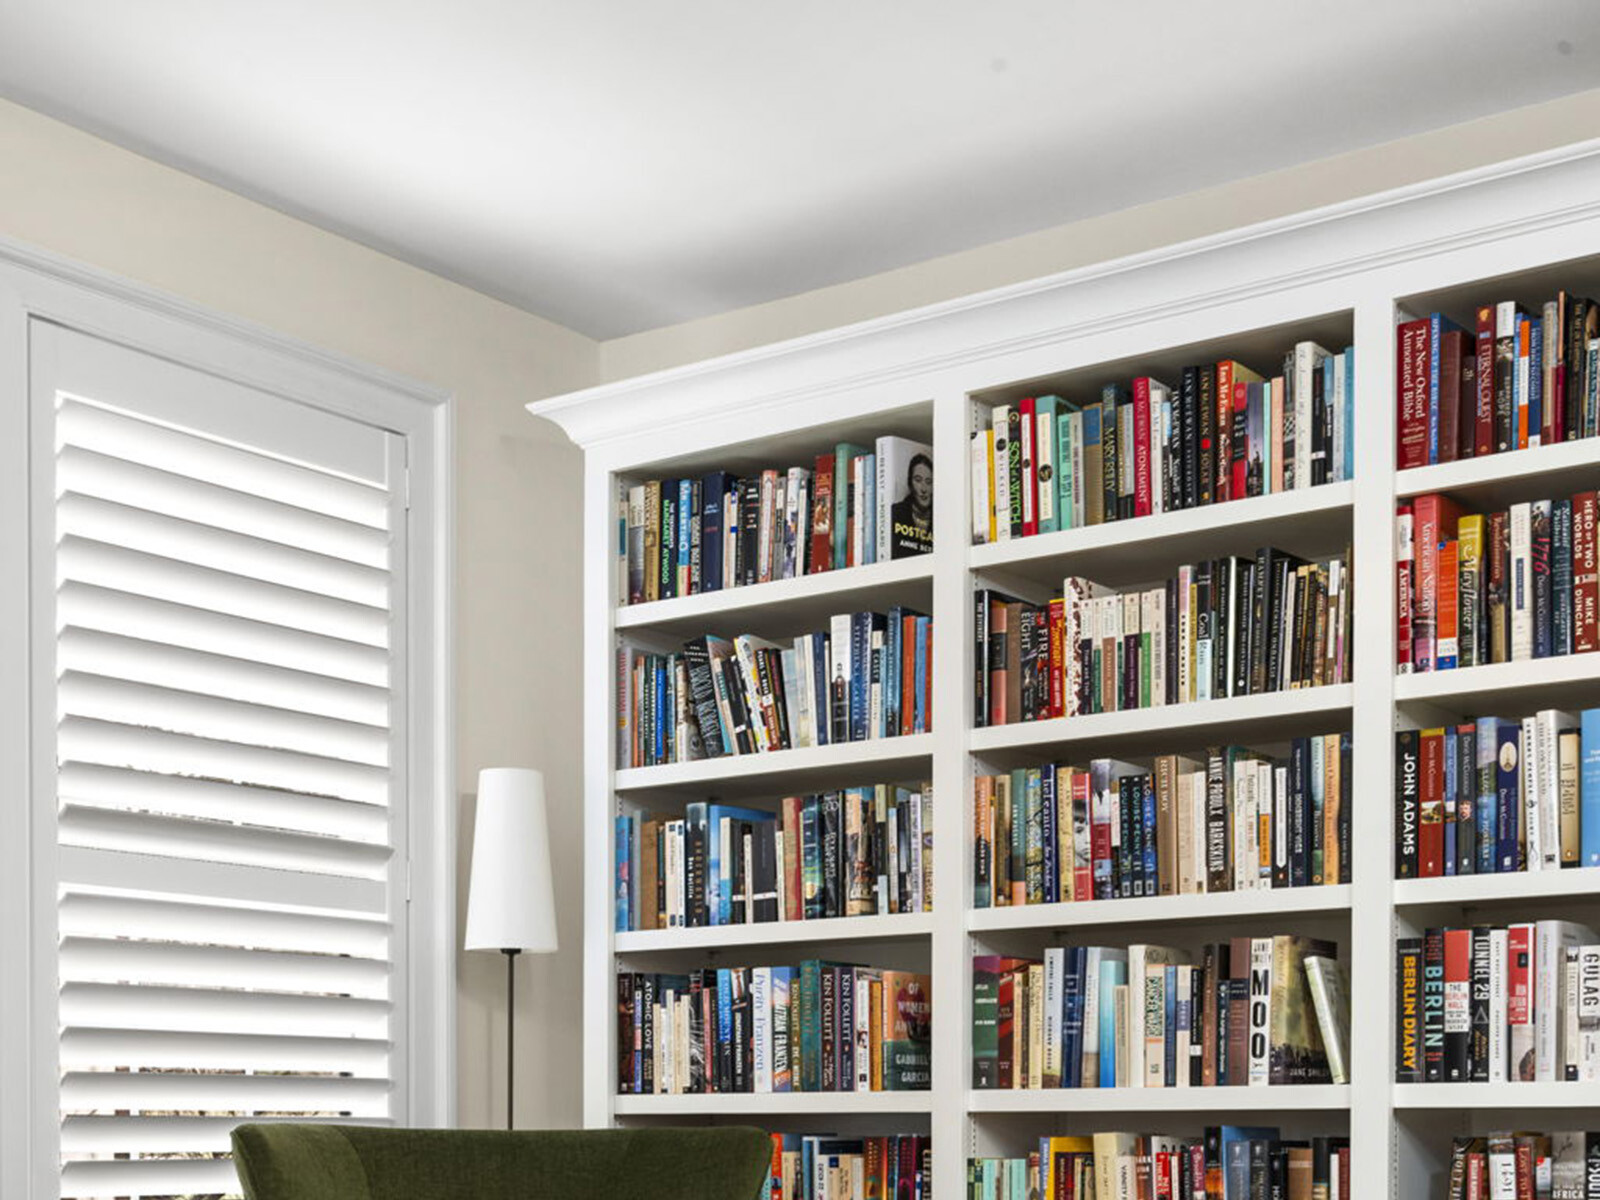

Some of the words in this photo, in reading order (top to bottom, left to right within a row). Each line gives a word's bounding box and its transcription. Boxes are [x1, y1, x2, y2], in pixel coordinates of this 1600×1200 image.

[1185, 374, 1193, 392] IAN
[1201, 370, 1210, 392] IAN
[1416, 350, 1428, 377] New
[1172, 390, 1180, 408] IAN
[1402, 390, 1414, 421] Bible
[1416, 378, 1428, 418] Oxford
[1139, 444, 1149, 503] ATONEMENT
[1200, 452, 1210, 485] SOLAR
[661, 500, 669, 546] MARGARET
[1584, 500, 1594, 530] HERO
[1574, 512, 1583, 560] WORLDS
[1584, 542, 1594, 568] TWO
[660, 548, 668, 584] ATWOOD
[1256, 556, 1266, 600] HAMNET
[1399, 568, 1409, 618] AMERICA
[1460, 544, 1478, 630] Mayflower
[1198, 612, 1210, 640] Coal
[1574, 589, 1584, 636] DUNCAN
[1585, 596, 1594, 626] MIKE
[1020, 612, 1032, 651] EIGHT
[1037, 628, 1049, 661] FIRE
[1403, 752, 1416, 795] JOHN
[1209, 783, 1224, 817] PROULX
[1209, 821, 1224, 872] BARKSKINS
[1403, 800, 1416, 856] ADAMS
[1474, 935, 1490, 981] TUNNEL
[644, 980, 652, 1021] ATOMIC
[824, 974, 832, 996] KEN
[842, 974, 852, 996] KEN
[1402, 956, 1418, 1014] BERLIN
[1474, 984, 1490, 1001] 29
[1582, 954, 1600, 1007] GULAG
[824, 998, 832, 1042] FOLLETT
[842, 998, 852, 1042] FOLLETT
[1426, 966, 1444, 1046] BERLIN
[644, 1023, 652, 1050] LOVE
[755, 1018, 766, 1071] Franzen
[1402, 1018, 1418, 1070] DIARY
